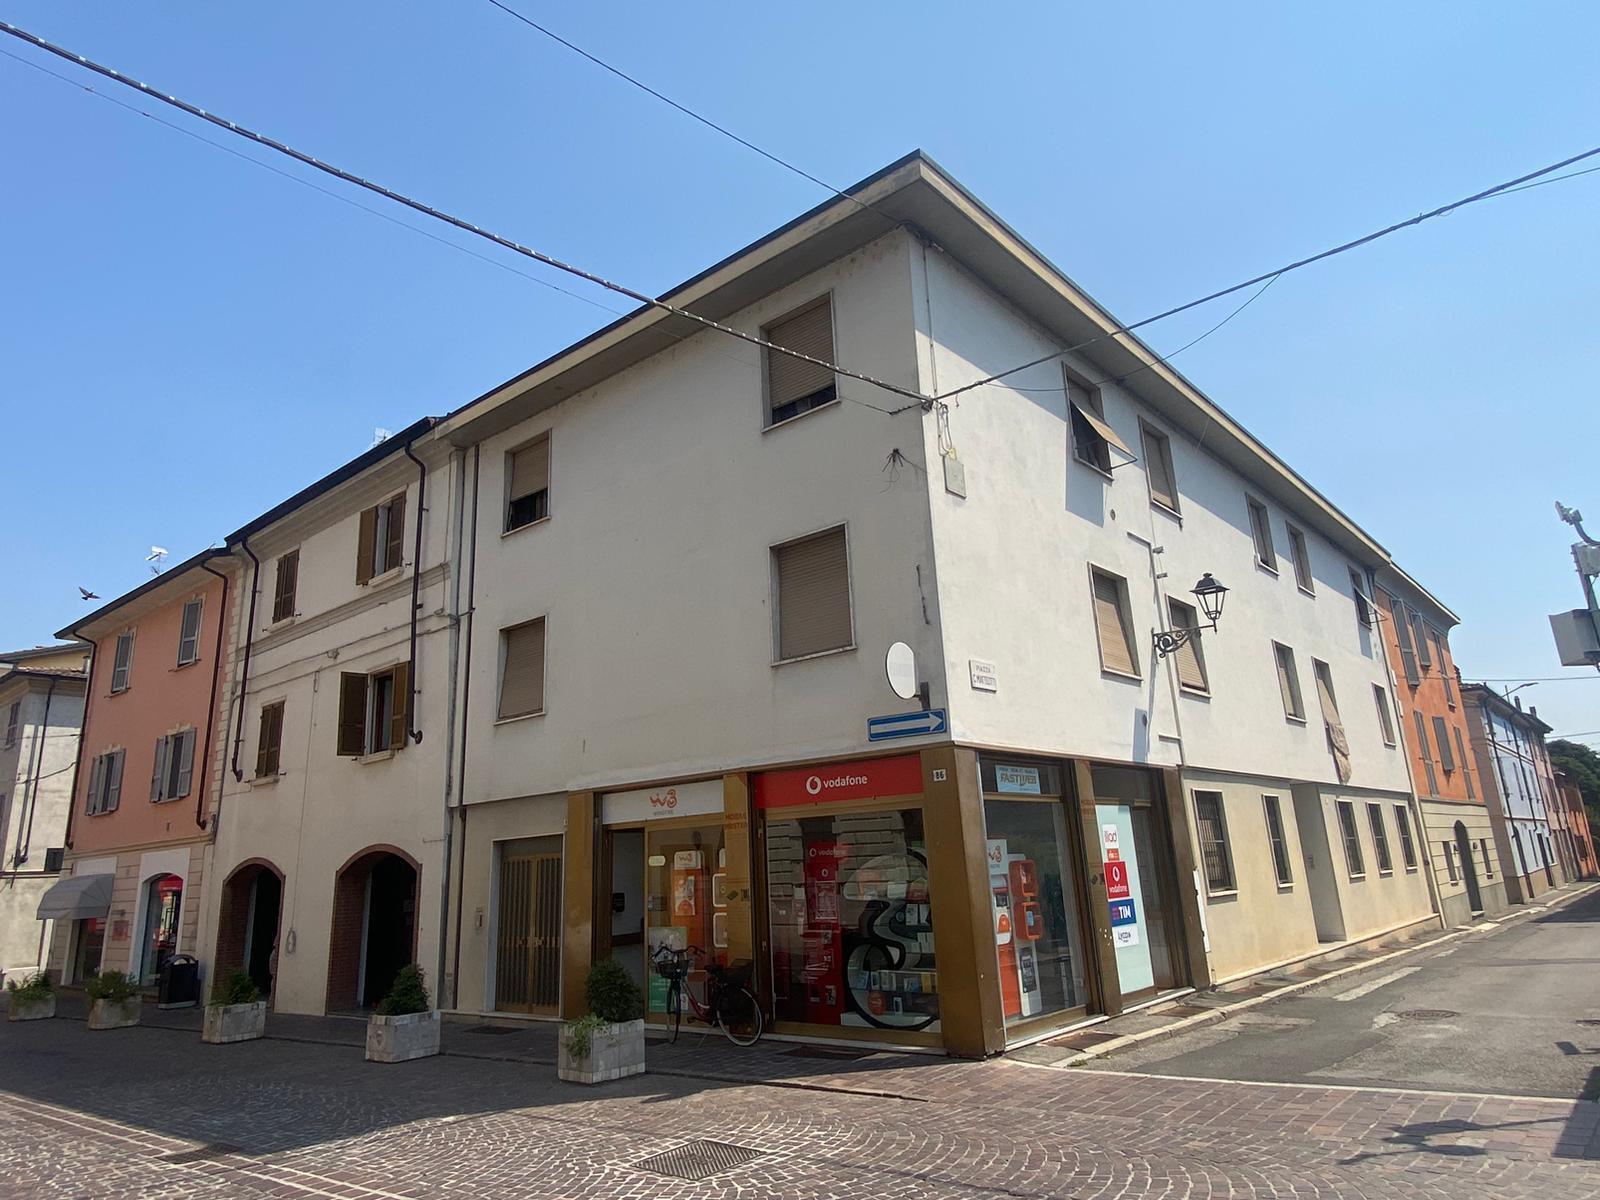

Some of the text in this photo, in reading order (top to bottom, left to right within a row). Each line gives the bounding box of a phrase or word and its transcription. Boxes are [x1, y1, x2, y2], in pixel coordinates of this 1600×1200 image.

[934, 770, 944, 779] 86
[823, 775, 868, 788] vodafone
[1109, 884, 1128, 894] vodafone
[1118, 905, 1132, 919] TIM
